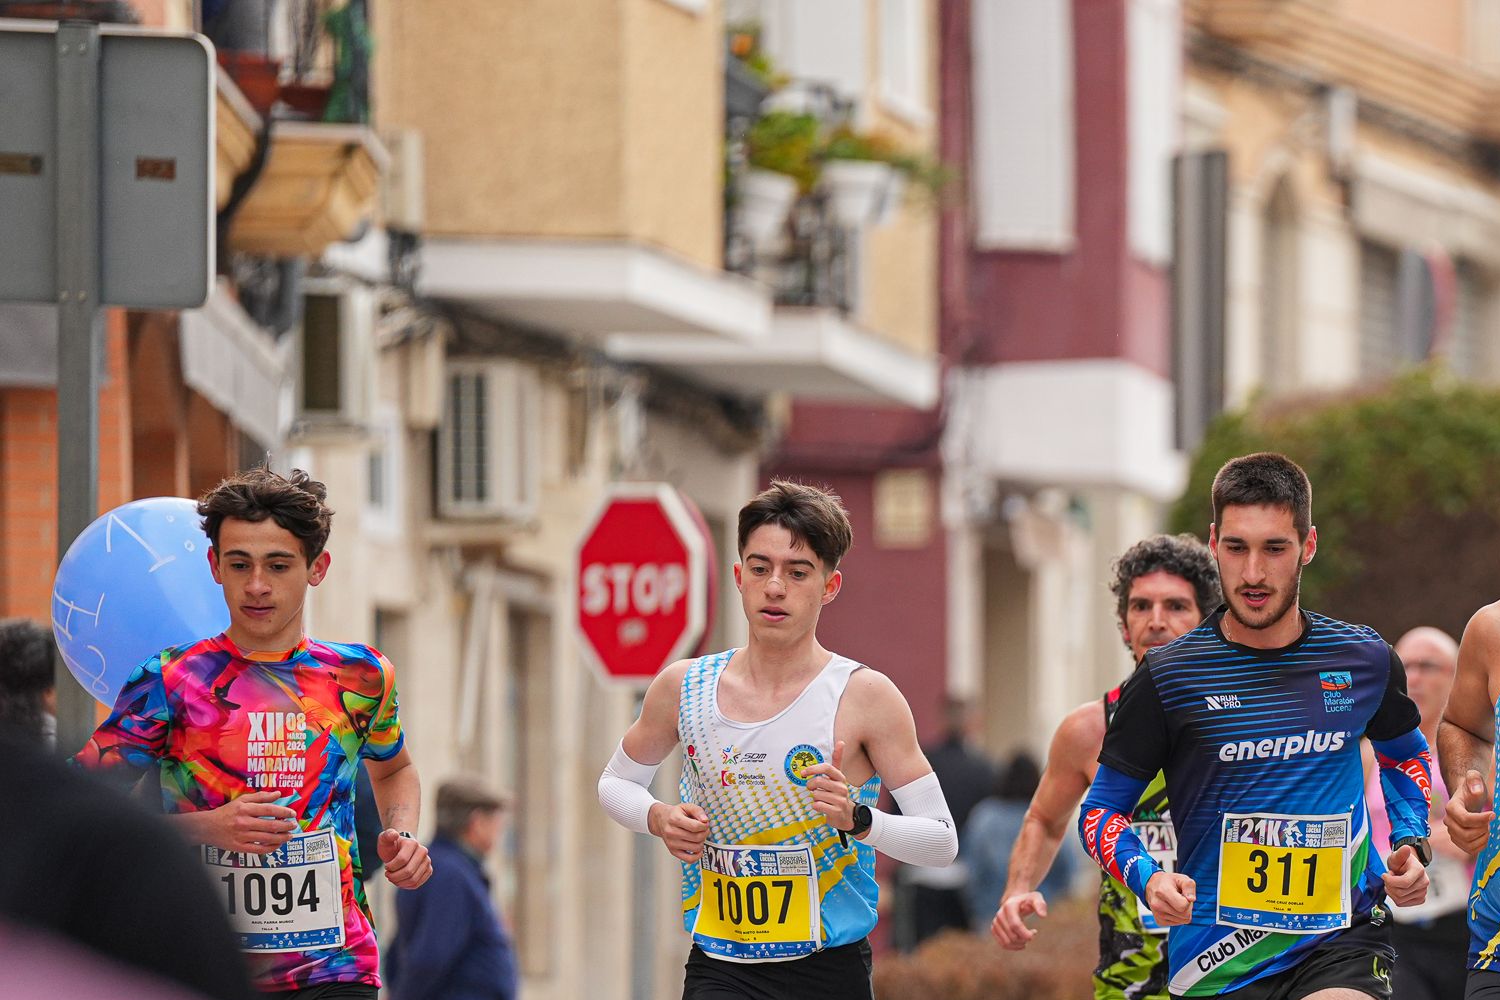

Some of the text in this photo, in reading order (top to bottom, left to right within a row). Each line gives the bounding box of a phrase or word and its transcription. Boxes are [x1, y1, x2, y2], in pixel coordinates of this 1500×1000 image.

[582, 562, 686, 616] STOP
[1324, 697, 1354, 705] Maratón
[1325, 704, 1352, 713] Lucena
[247, 712, 284, 741] XII
[286, 712, 306, 731] 08
[248, 742, 286, 756] MEDIA
[287, 741, 306, 750] 2026
[248, 754, 306, 772] MARATÓN
[247, 773, 277, 787] & 10K
[738, 773, 765, 781] Diputación
[1240, 819, 1282, 846] 21K
[288, 856, 303, 865] 2026
[708, 846, 737, 877] 21K
[761, 866, 778, 875] 2026
[1247, 849, 1318, 896] 311
[221, 869, 320, 916] 1094
[713, 878, 793, 925] 1007
[1197, 941, 1235, 973] Club
